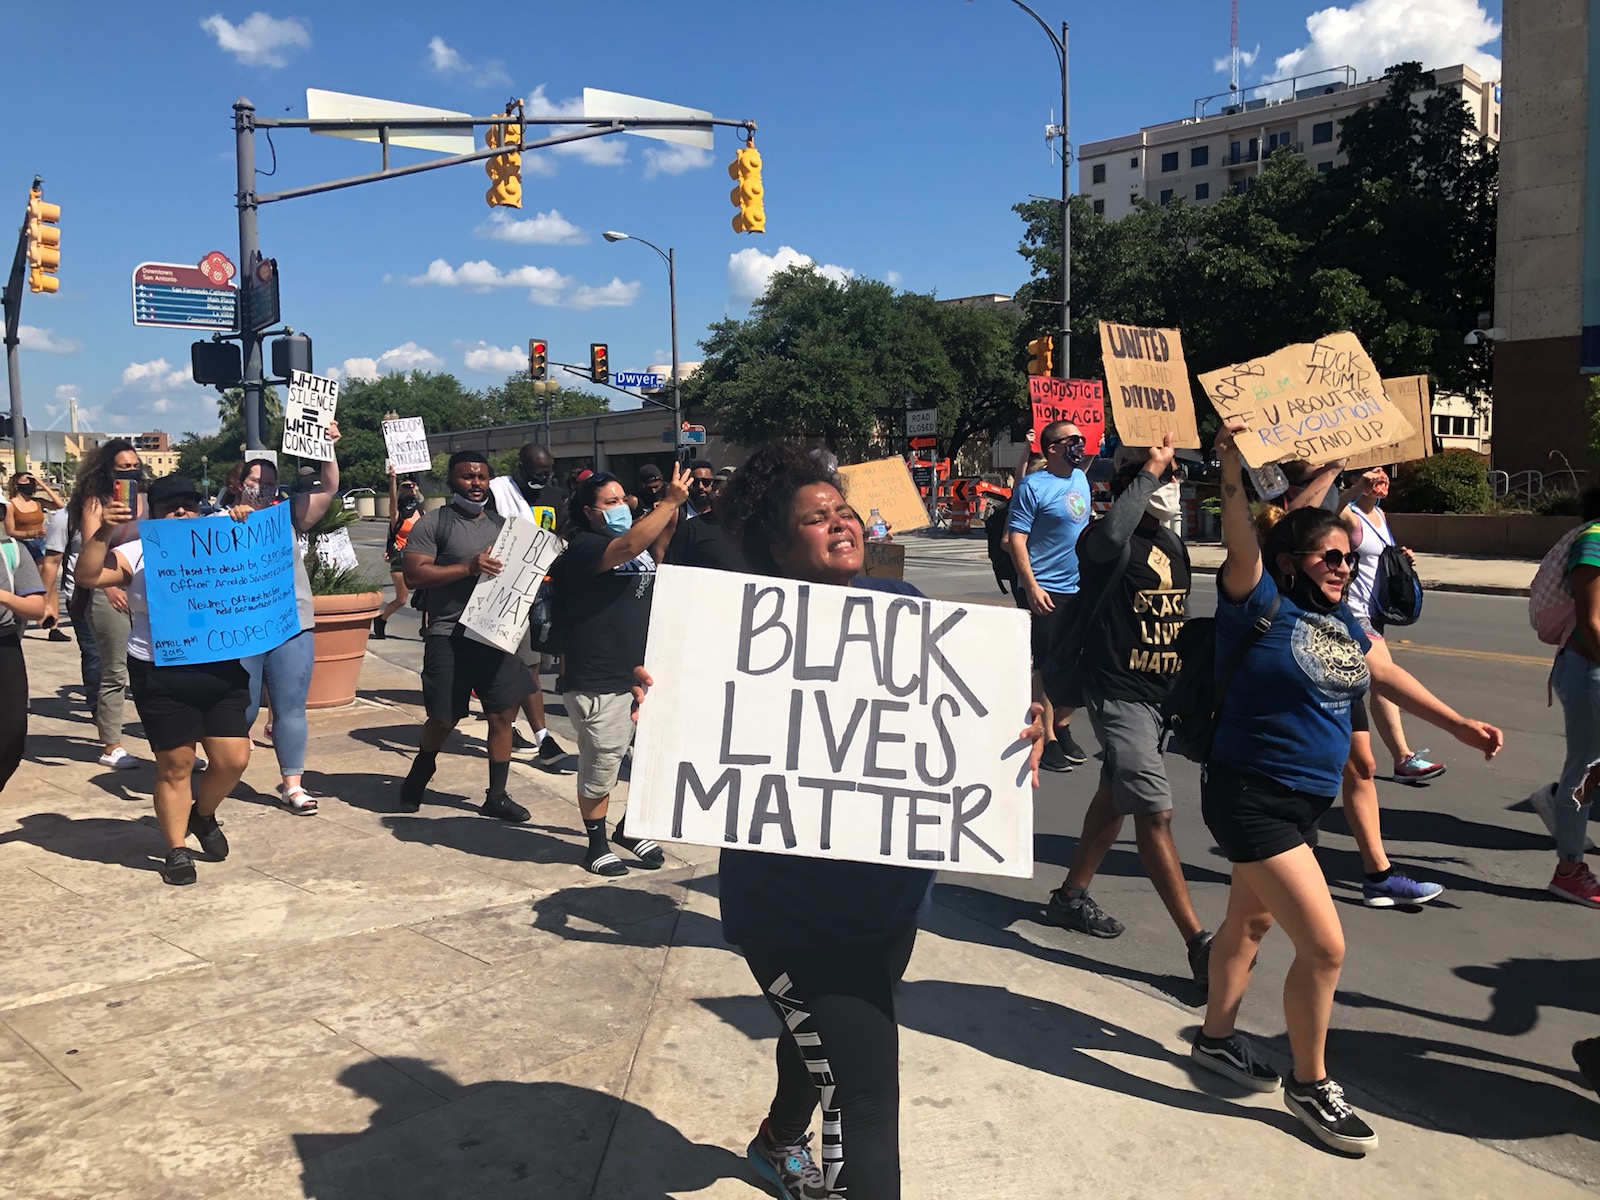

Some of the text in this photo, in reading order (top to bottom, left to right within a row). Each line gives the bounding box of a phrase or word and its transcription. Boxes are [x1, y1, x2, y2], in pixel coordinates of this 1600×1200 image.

[142, 268, 173, 276] Downtown
[1107, 325, 1169, 362] UNITED
[1311, 342, 1361, 373] FUCK
[291, 370, 337, 396] WHITE
[618, 374, 656, 386] Dwyer
[1136, 362, 1174, 384] STAND
[1306, 364, 1370, 390] TRUMP
[290, 387, 335, 412] SILENCE
[1033, 381, 1102, 401] NO JUSTICE
[1120, 384, 1176, 412] DIVIDED
[1211, 364, 1264, 410] ACAB
[1252, 377, 1296, 400] BLM
[912, 413, 930, 422] ROAD
[1036, 406, 1100, 424] NO PEACE
[1262, 405, 1281, 426] U
[1286, 390, 1342, 418] ABOUT
[1344, 387, 1372, 404] THE
[286, 418, 332, 442] WHITE
[382, 418, 424, 435] FREEDOM
[909, 423, 934, 433] CLOSED
[1258, 396, 1382, 448] REVOLUTION
[284, 432, 334, 458] CONSENT
[388, 440, 427, 454] CONSTANT
[1294, 420, 1384, 458] STAND UP
[391, 450, 429, 467] STRUGGLE
[205, 566, 217, 575] to
[1133, 592, 1186, 618] BLAC
[155, 640, 182, 650] APRIL
[162, 648, 184, 657] 2015
[737, 583, 988, 718] BLACK
[719, 681, 961, 786] LIVES
[672, 762, 1004, 864] MATTER
[767, 971, 848, 1200] VALENTIN
